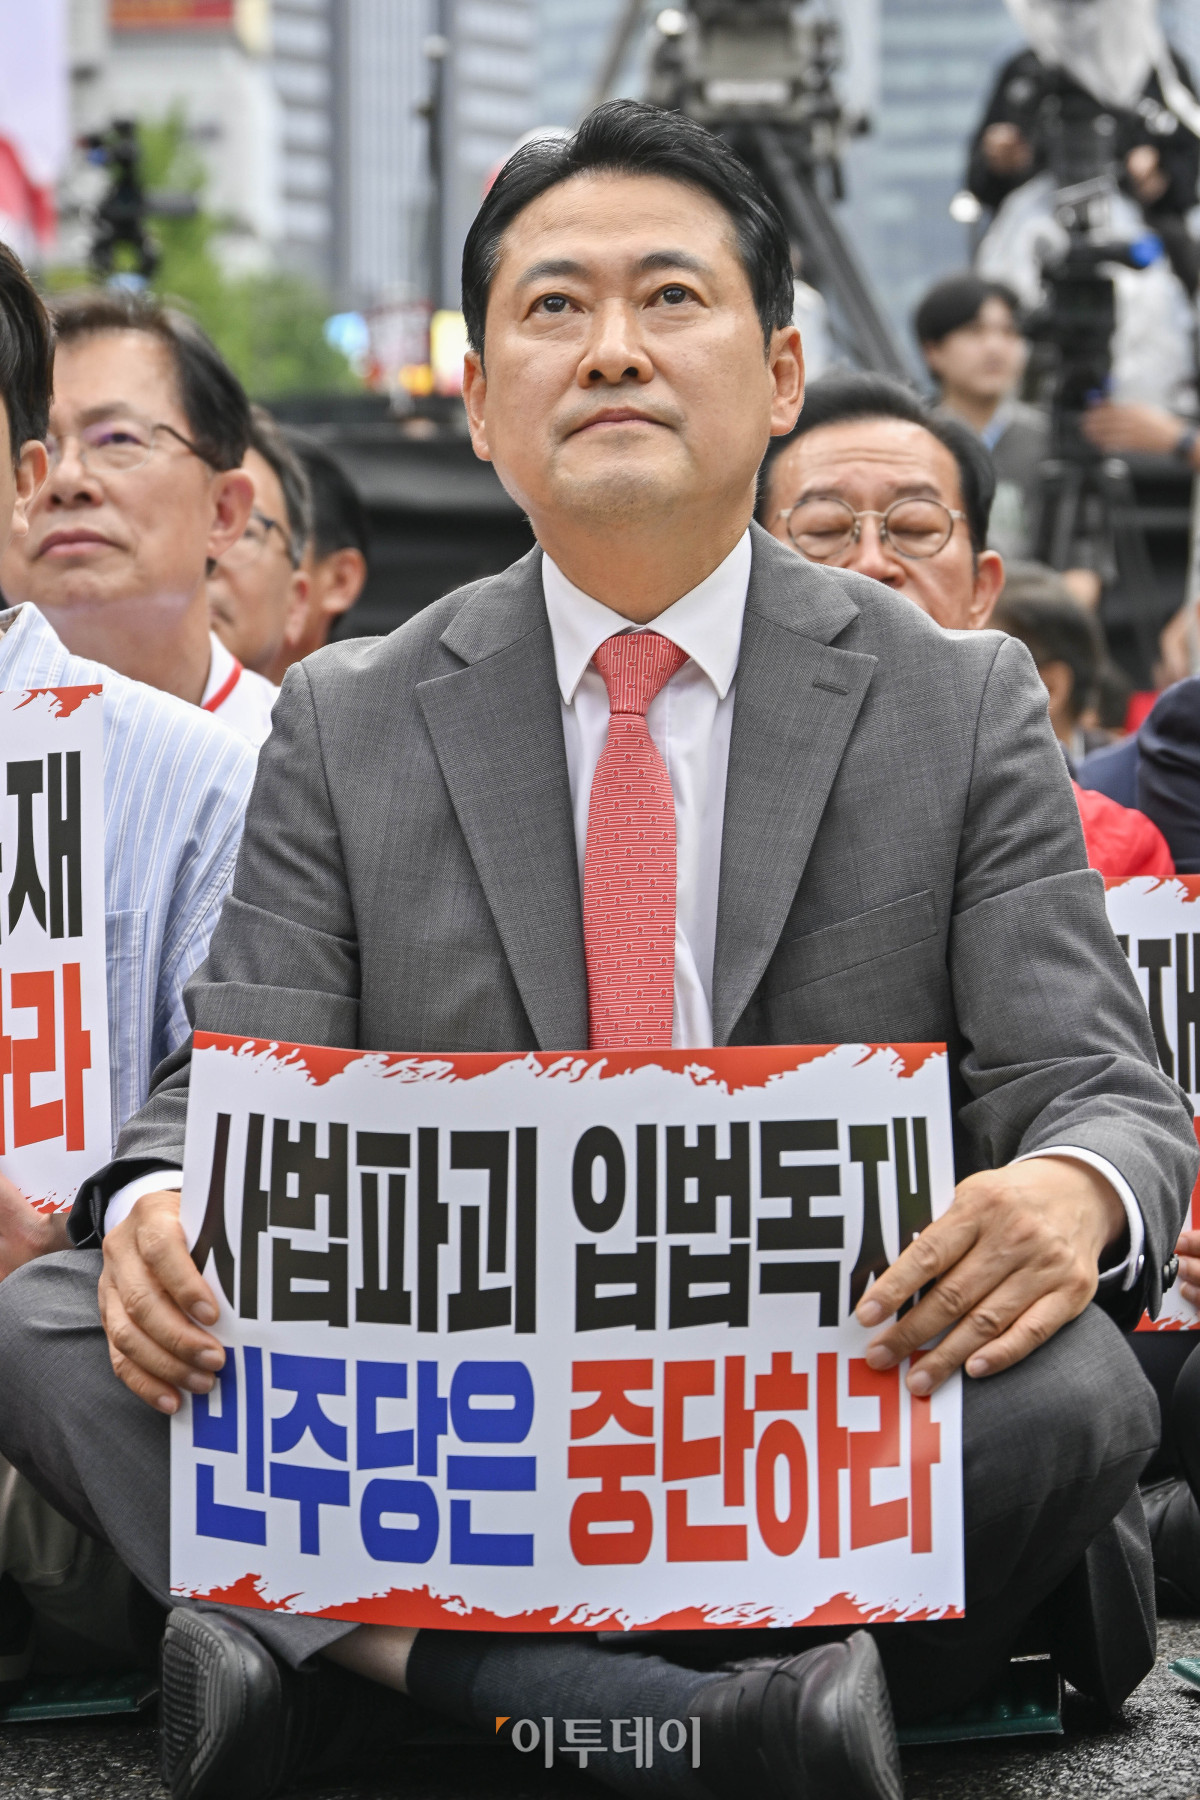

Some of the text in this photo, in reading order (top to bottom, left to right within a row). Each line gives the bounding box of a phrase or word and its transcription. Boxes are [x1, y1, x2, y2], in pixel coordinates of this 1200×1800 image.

[0, 750, 83, 944] 재
[0, 962, 91, 1156] 라
[1115, 932, 1200, 1094] 재
[190, 1112, 538, 1334] 사법파괴
[571, 1116, 933, 1333] 입법독재
[191, 1345, 941, 1567] 민주당은 중단하라
